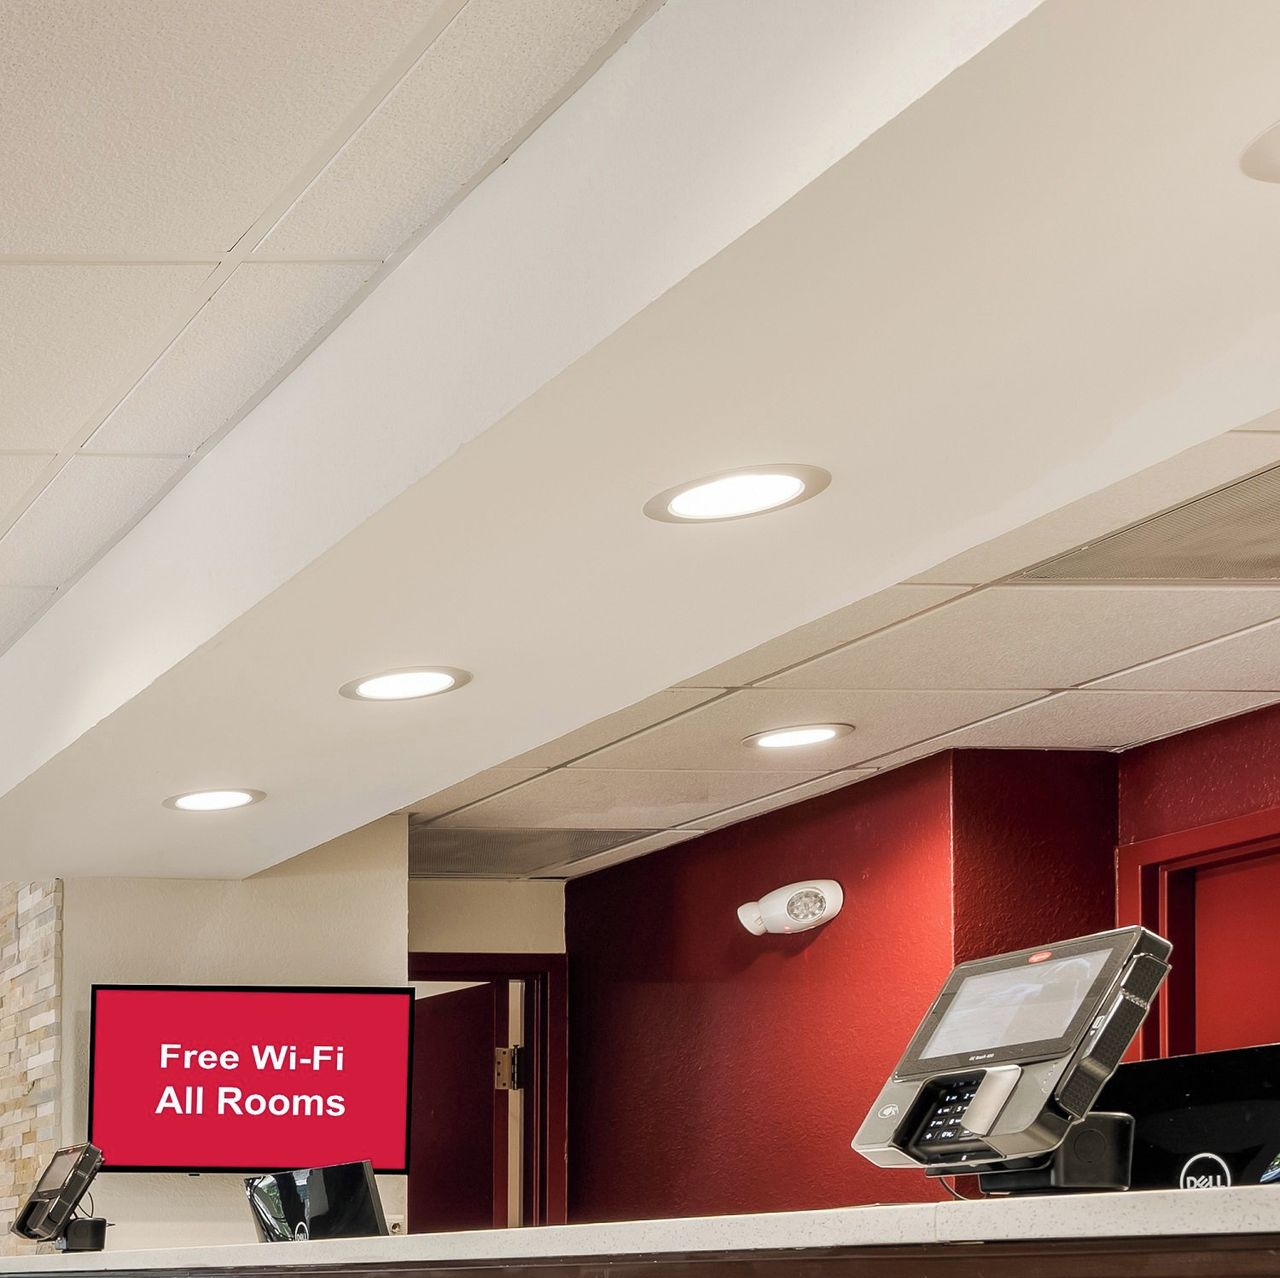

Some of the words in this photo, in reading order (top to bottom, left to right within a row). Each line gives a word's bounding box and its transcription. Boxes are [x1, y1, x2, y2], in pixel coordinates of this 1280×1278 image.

[160, 1043, 240, 1070] Free
[251, 1044, 344, 1071] Wi-Fi
[154, 1085, 204, 1115] All
[217, 1086, 346, 1117] Rooms
[1186, 1175, 1227, 1189] DELL
